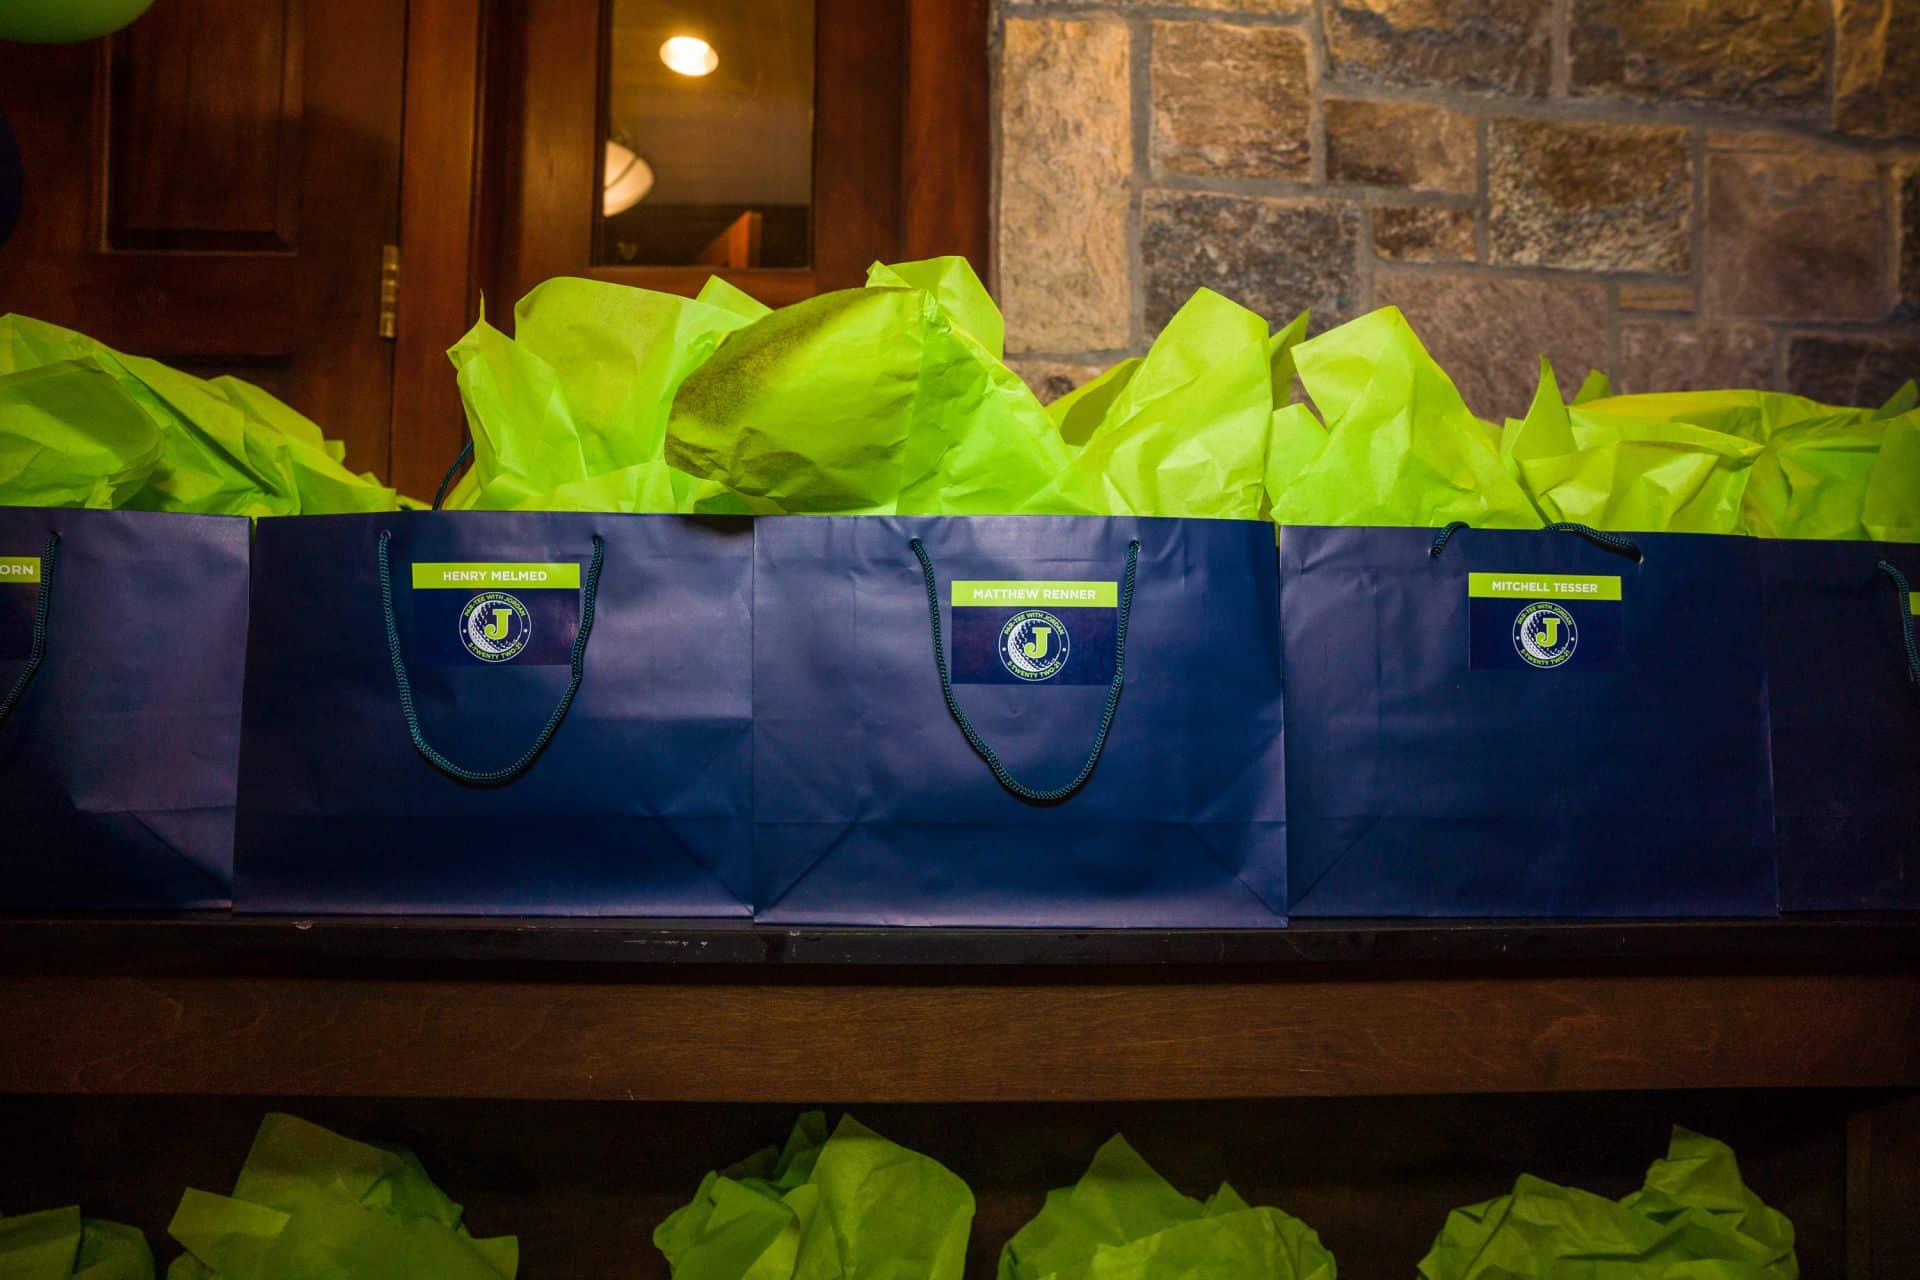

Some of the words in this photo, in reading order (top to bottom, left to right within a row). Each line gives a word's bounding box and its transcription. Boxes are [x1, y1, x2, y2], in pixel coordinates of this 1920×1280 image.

[0, 564, 34, 576] ORN
[443, 570, 487, 581] HENRY
[491, 571, 548, 581] MELMED
[973, 588, 1039, 600] MATTHEW
[1043, 588, 1097, 600] RENNER
[1492, 580, 1550, 592] MITCHELL
[1553, 582, 1598, 593] TESSER
[486, 593, 504, 601] WITH
[504, 596, 526, 617] JORDAN
[484, 608, 513, 640] J
[1044, 614, 1065, 635] JORDAN
[1535, 617, 1561, 648] J
[1023, 626, 1052, 659] J
